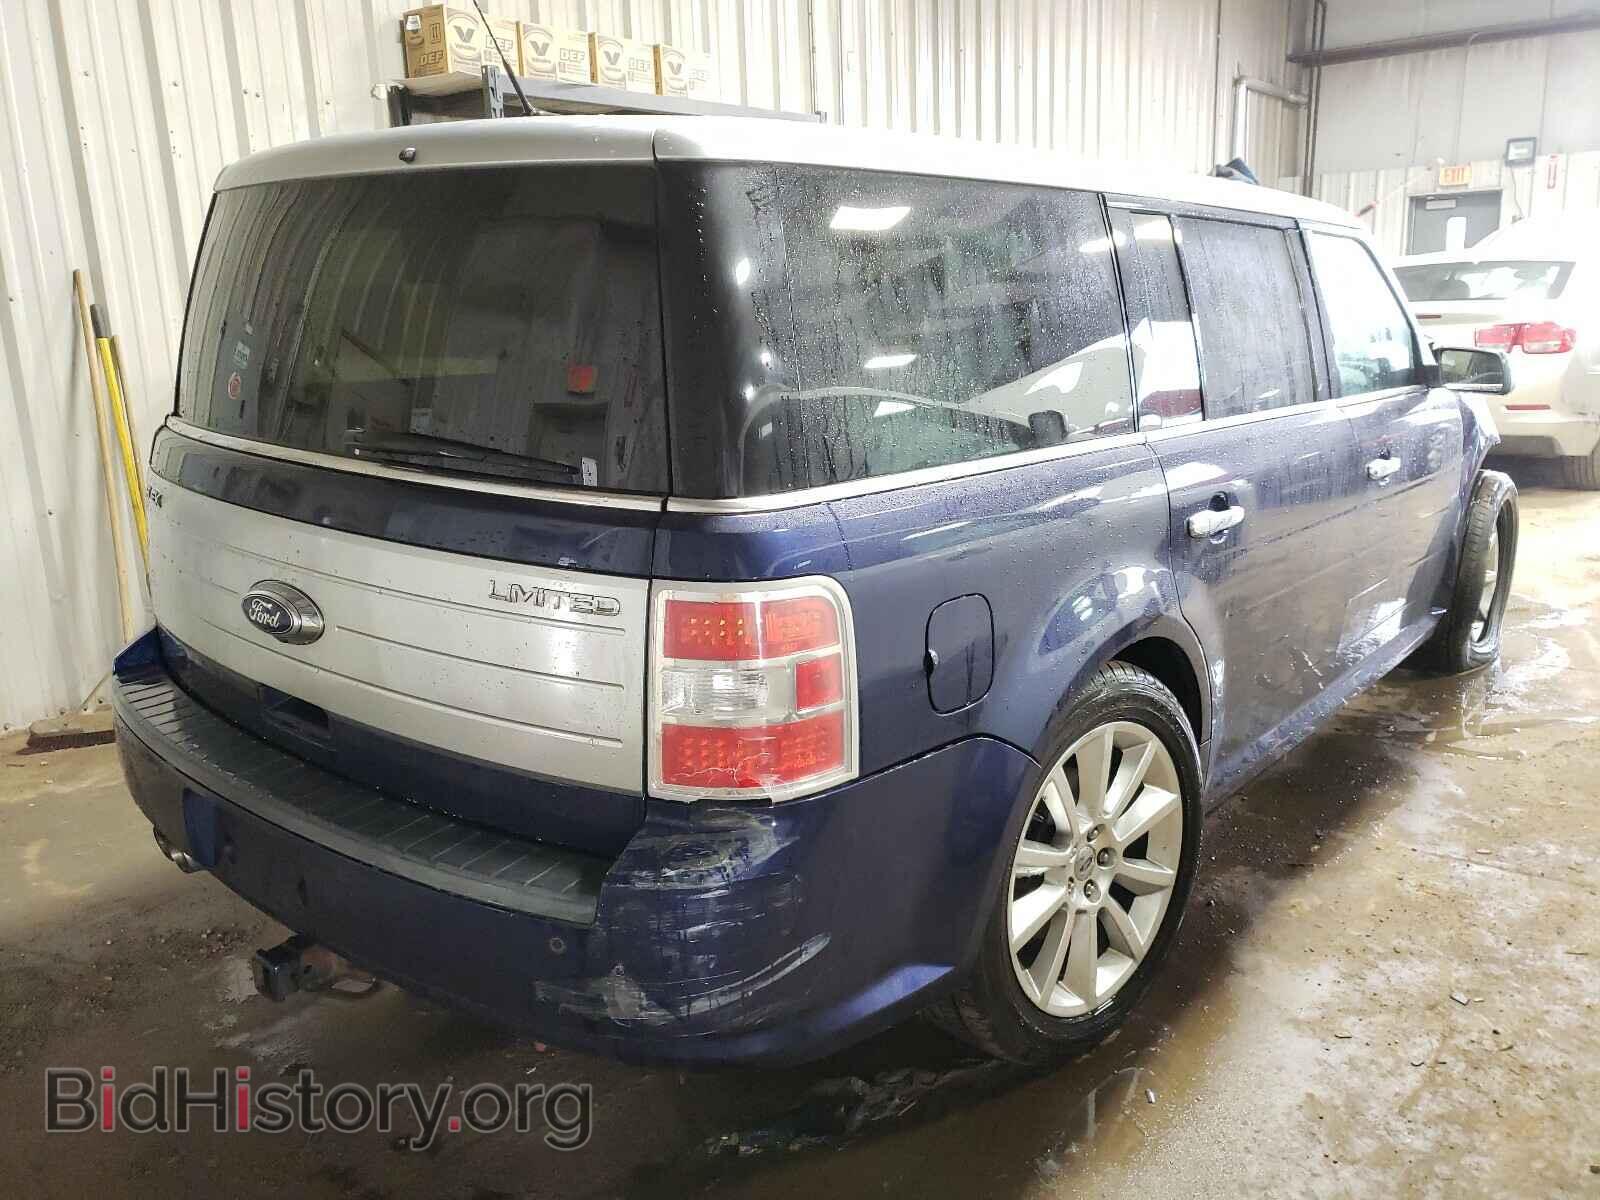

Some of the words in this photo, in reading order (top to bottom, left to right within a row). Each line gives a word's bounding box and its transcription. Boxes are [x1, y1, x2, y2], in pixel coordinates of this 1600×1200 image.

[420, 50, 444, 66] DEF
[559, 48, 585, 62] DEF
[1444, 167, 1465, 183] EXIT
[488, 577, 621, 618] LIMITED
[248, 598, 281, 628] Ford
